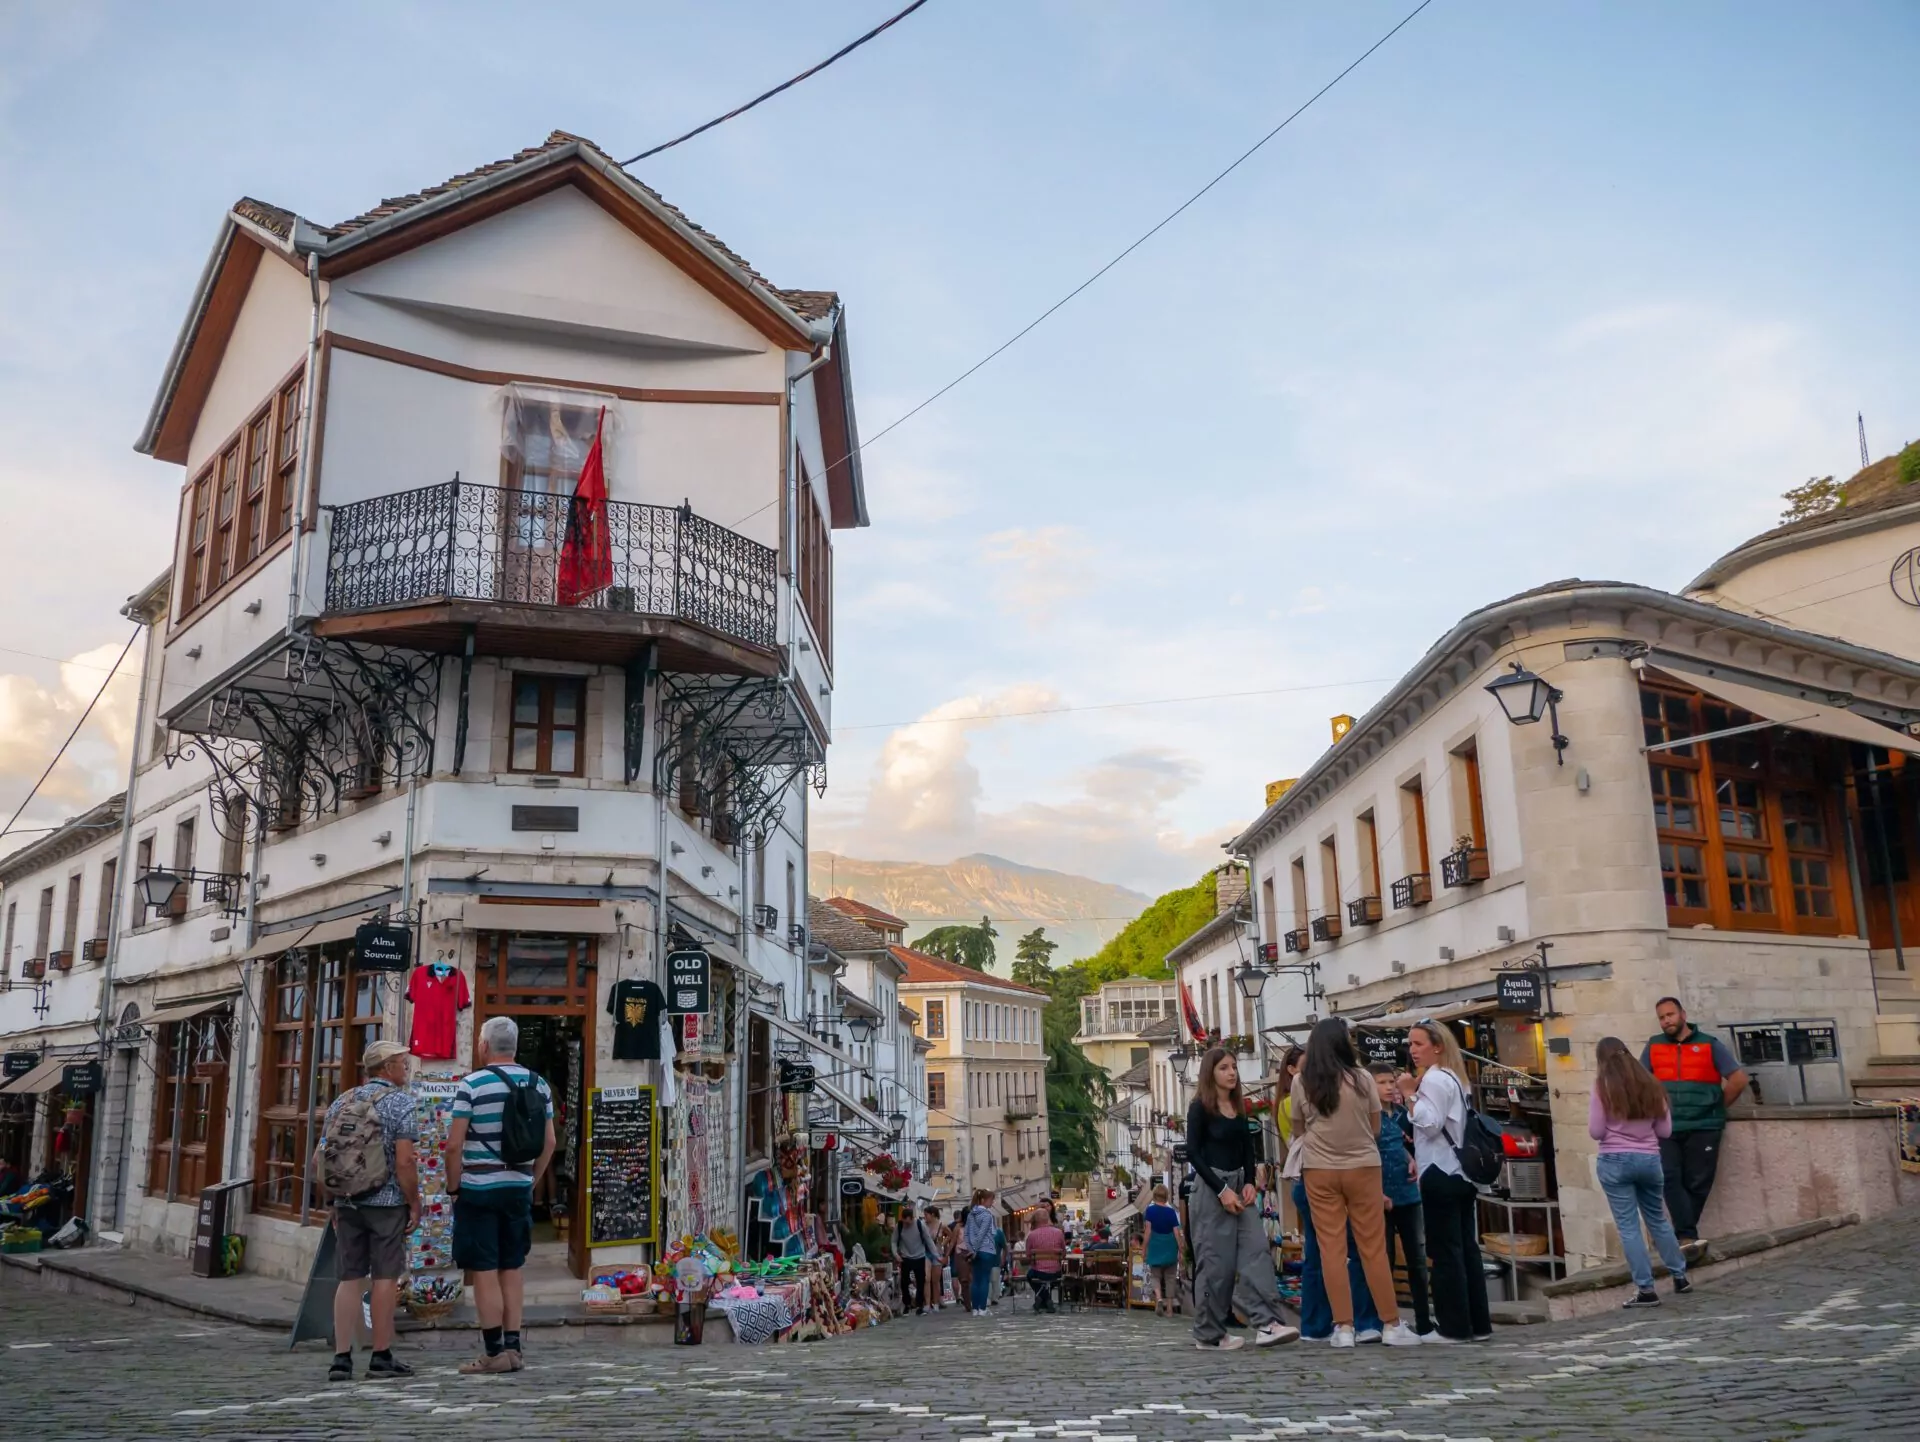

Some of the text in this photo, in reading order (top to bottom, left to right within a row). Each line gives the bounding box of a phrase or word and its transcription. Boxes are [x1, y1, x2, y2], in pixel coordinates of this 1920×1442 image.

[371, 936, 396, 947] Alma
[363, 949, 403, 960] Souvenir
[674, 959, 702, 970] OLD
[673, 974, 703, 985] WELL
[1504, 979, 1533, 989] Aquila
[1503, 988, 1535, 998] Liquori
[1378, 1043, 1387, 1051] &
[1369, 1050, 1397, 1059] Carpet
[603, 1087, 637, 1098] SILVER 925
